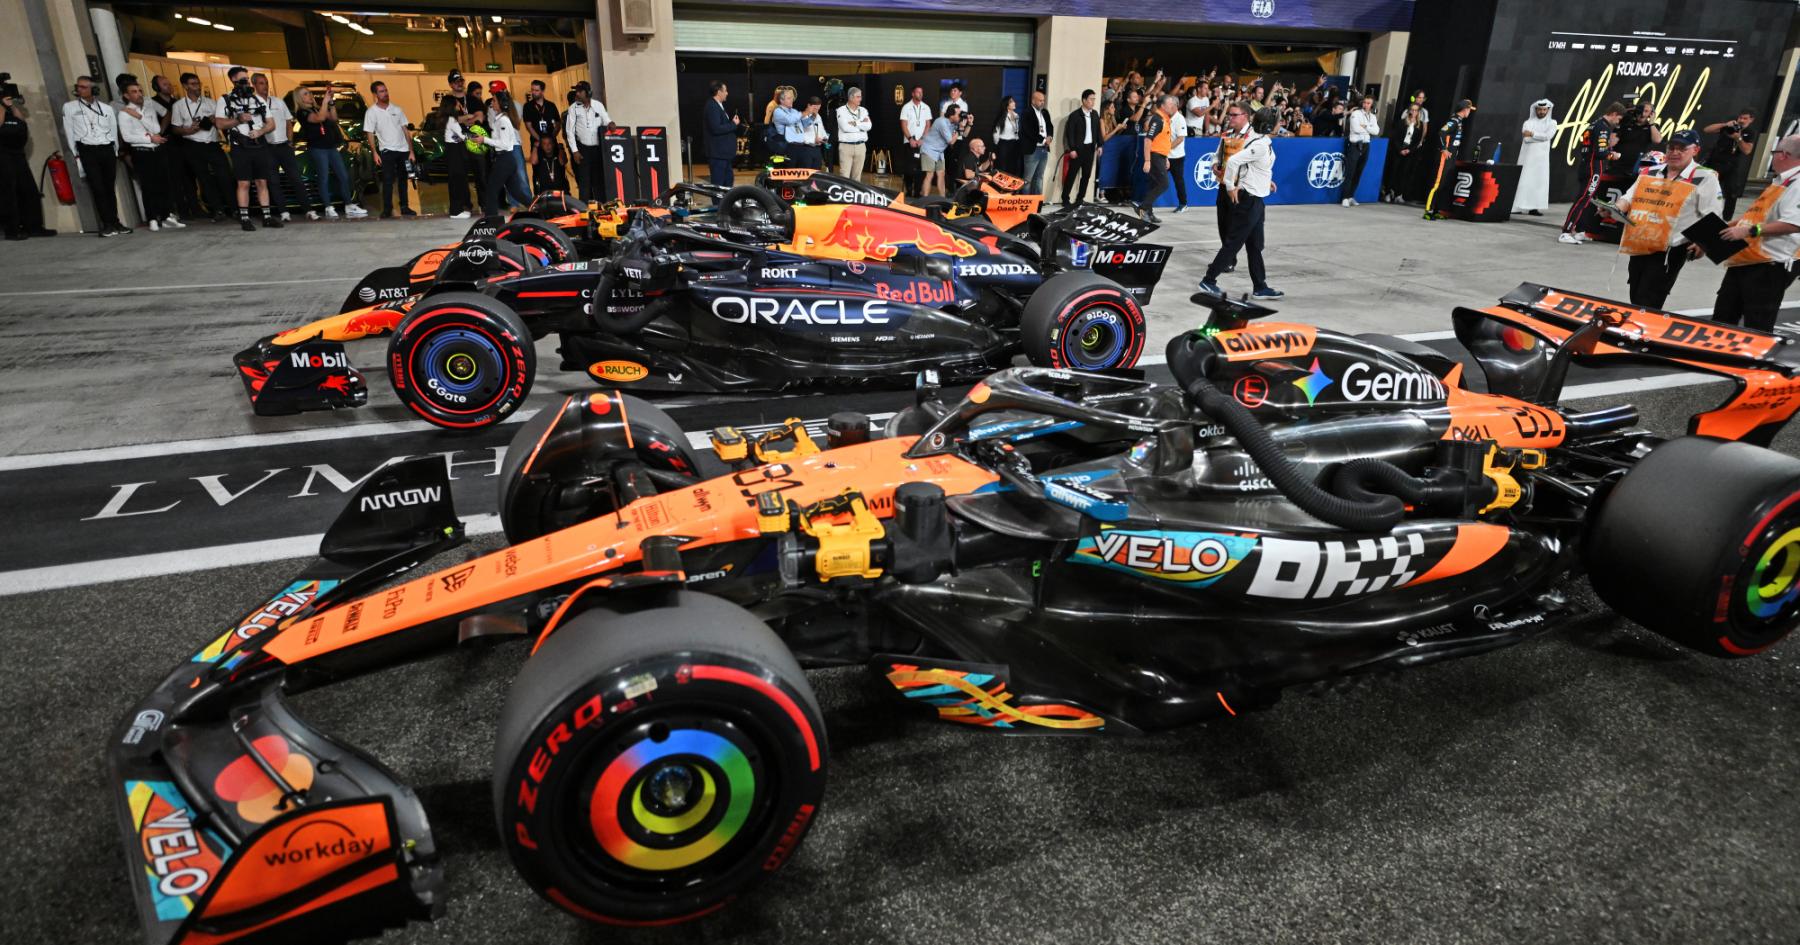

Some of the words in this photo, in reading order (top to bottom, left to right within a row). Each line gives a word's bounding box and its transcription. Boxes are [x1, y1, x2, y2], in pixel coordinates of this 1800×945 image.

[1253, 2, 1272, 15] FIA
[1616, 61, 1651, 76] ROUND
[1653, 63, 1669, 77] 24
[610, 144, 625, 163] 3
[646, 144, 660, 162] 1
[772, 169, 810, 178] allwyn
[1453, 172, 1473, 198] 2
[1096, 249, 1146, 264] Mobil
[624, 266, 642, 279] YETI
[761, 268, 798, 279] ROKT
[959, 263, 1037, 277] HONDA
[379, 287, 410, 299] AT&T
[876, 282, 916, 304] Red
[918, 280, 955, 303] Bull
[711, 296, 890, 325] ORACLE
[1225, 330, 1308, 353] allwyn
[291, 352, 347, 368] Mobil
[501, 329, 517, 343] P
[511, 345, 527, 399] ZERO
[605, 365, 641, 375] RAUCH
[1199, 425, 1225, 437] okta
[1095, 534, 1229, 574] VELO
[382, 588, 406, 620] FxPro
[236, 591, 317, 640] VELO
[518, 693, 603, 815] ZERO
[515, 821, 538, 849] P
[144, 807, 208, 896] VELO
[264, 837, 376, 867] workday
